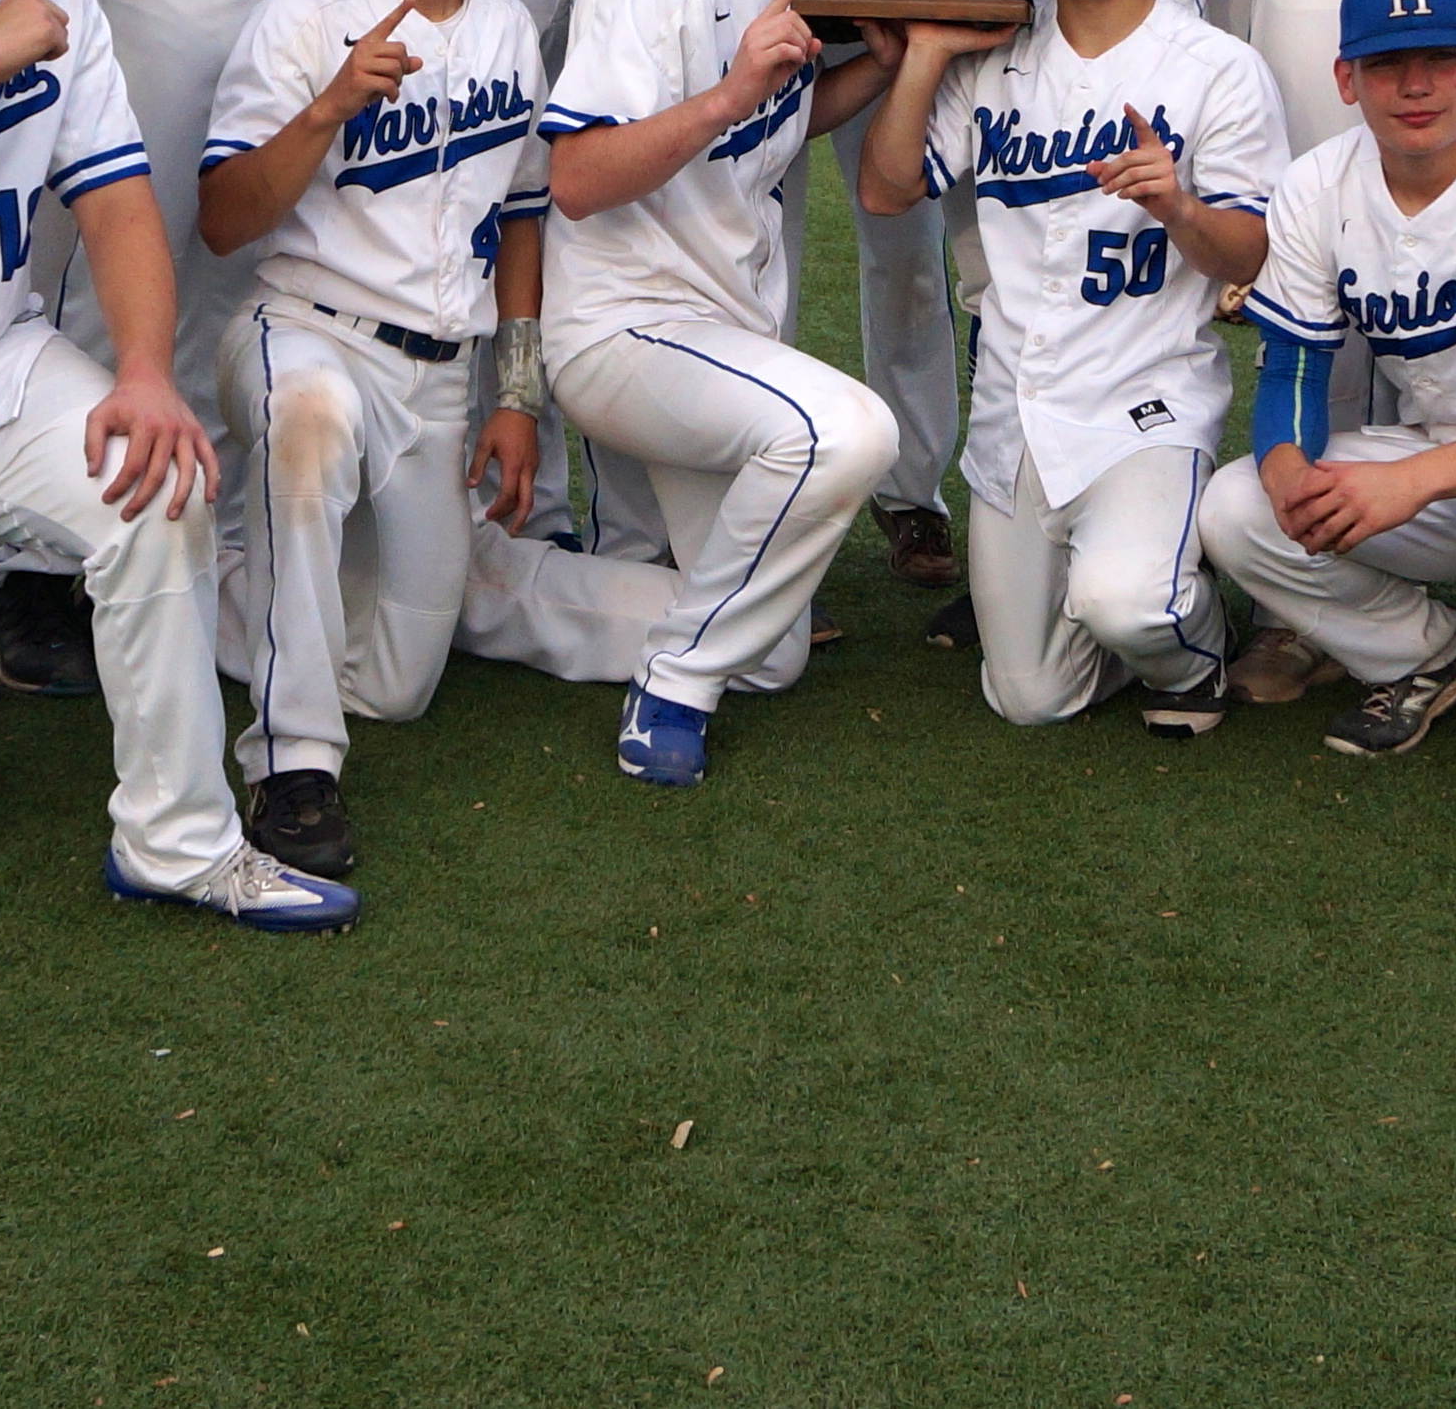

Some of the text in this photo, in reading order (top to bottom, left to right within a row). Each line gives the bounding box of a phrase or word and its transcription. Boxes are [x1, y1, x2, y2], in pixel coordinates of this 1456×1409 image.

[973, 105, 1183, 175] Warriors
[1081, 228, 1167, 306] 50
[1140, 403, 1156, 415] M
